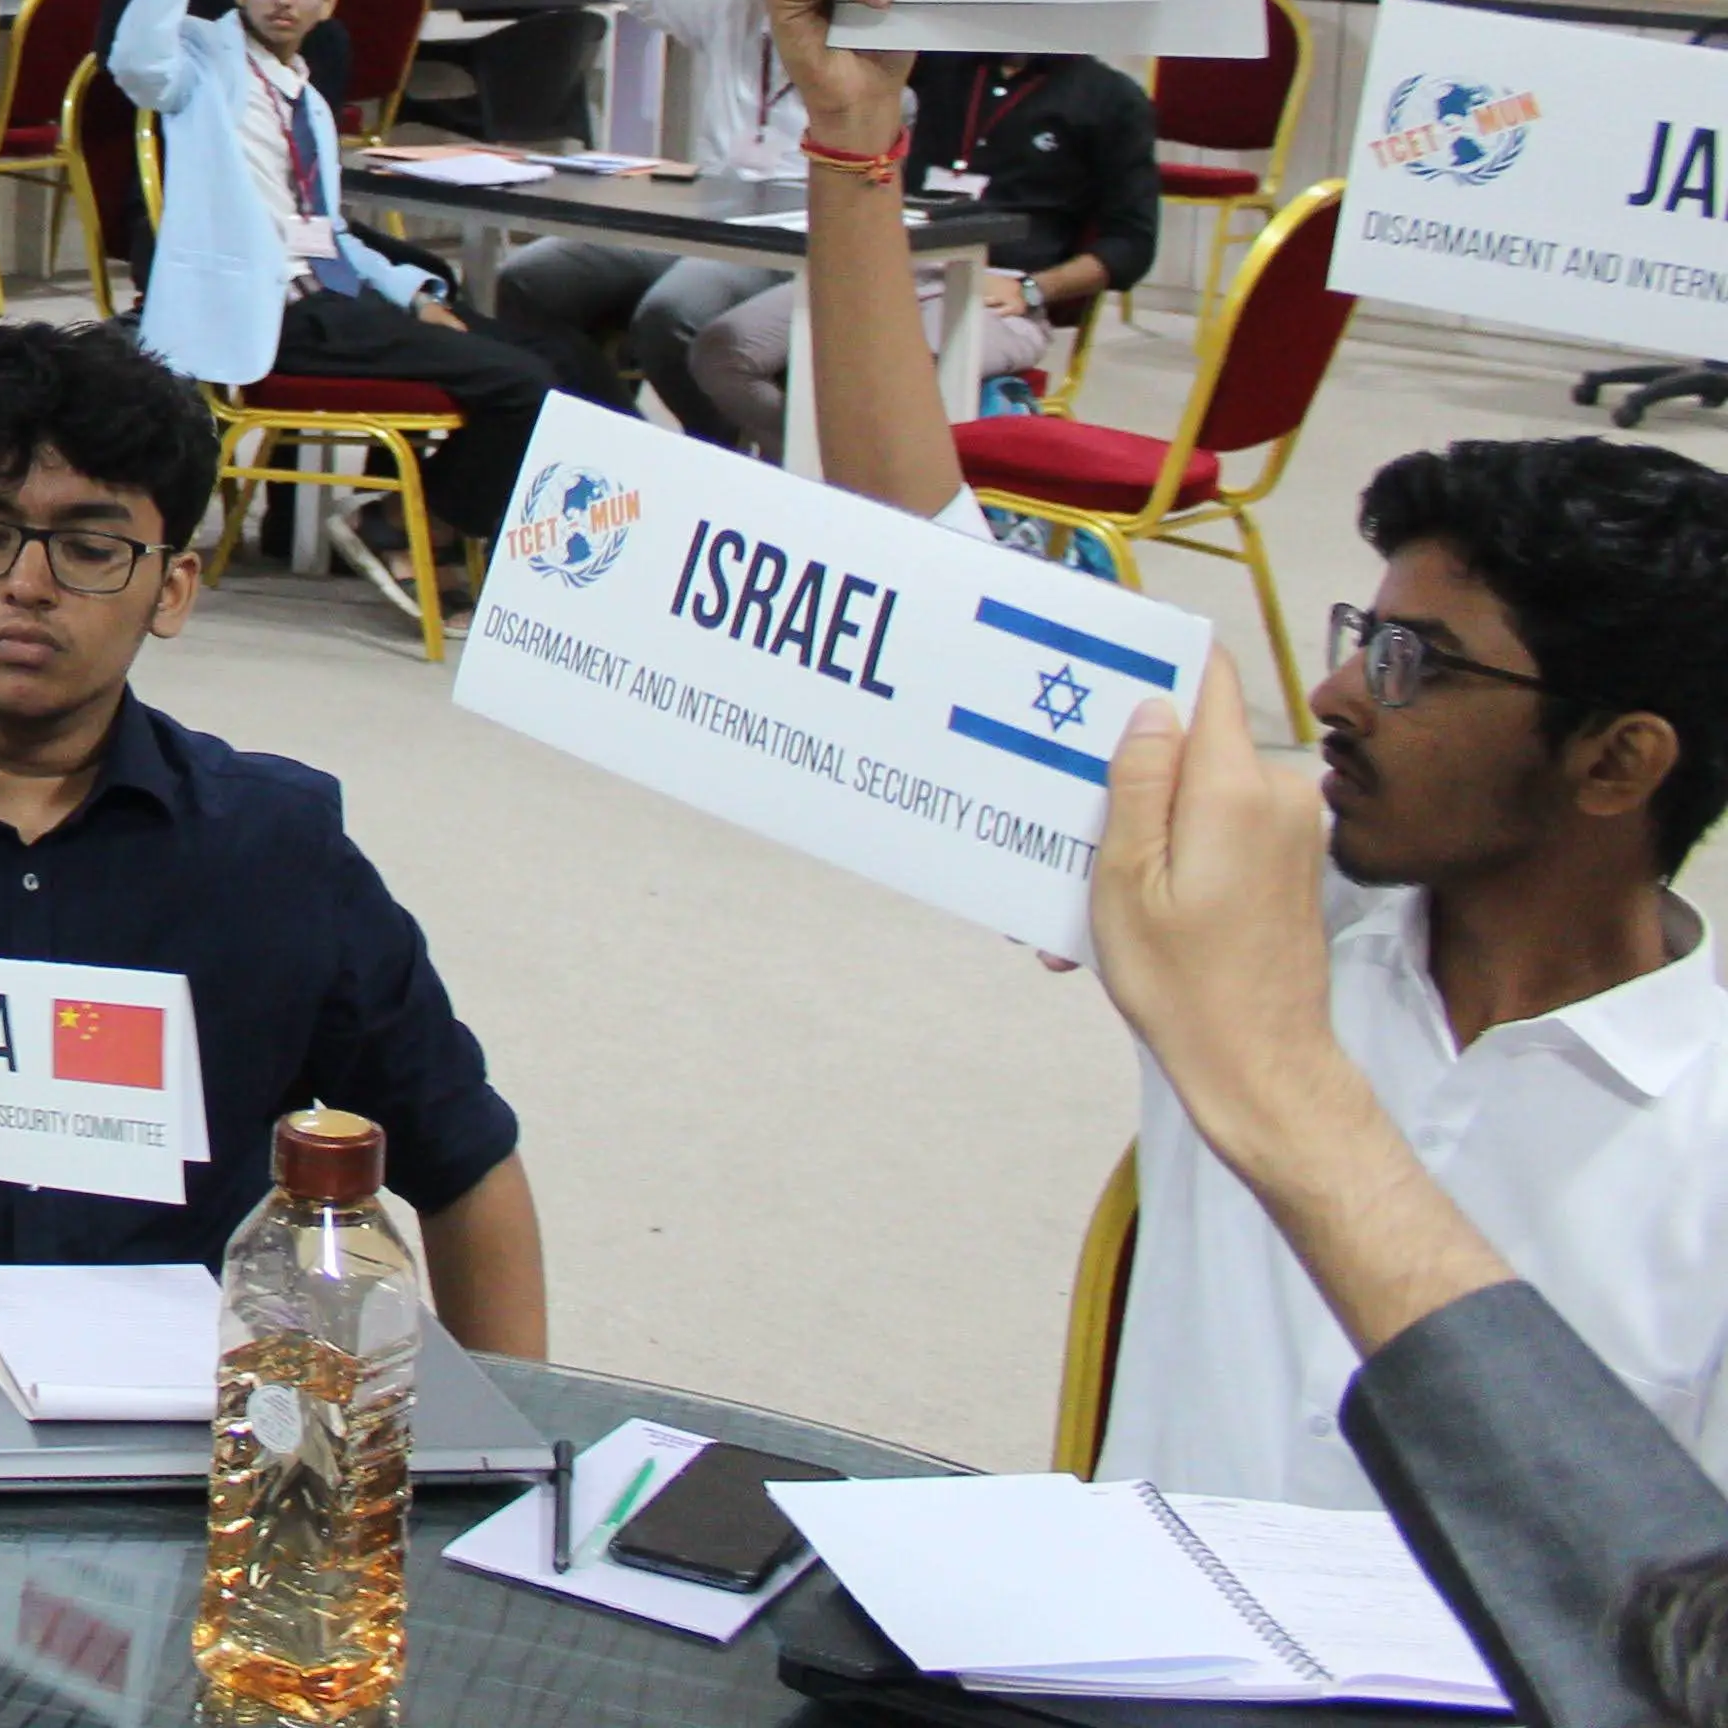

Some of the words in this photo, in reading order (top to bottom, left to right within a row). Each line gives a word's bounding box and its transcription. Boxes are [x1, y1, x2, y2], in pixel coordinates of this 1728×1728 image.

[1368, 124, 1441, 170] TCET
[1471, 90, 1543, 138] MUN
[1625, 120, 1728, 222] JA
[1361, 210, 1561, 275] DISARMAMENT
[1561, 246, 1624, 287] AND
[505, 516, 560, 561] TCET
[590, 489, 642, 534] MUN
[669, 518, 898, 700] ISRAEL
[483, 604, 634, 693] DISARMAMENT
[629, 665, 677, 712] AND
[676, 686, 848, 786] INTERNATIONAL
[853, 756, 975, 832] SECURITY
[975, 804, 1102, 882] COMMITT
[72, 1113, 168, 1148] COMMITTEE
